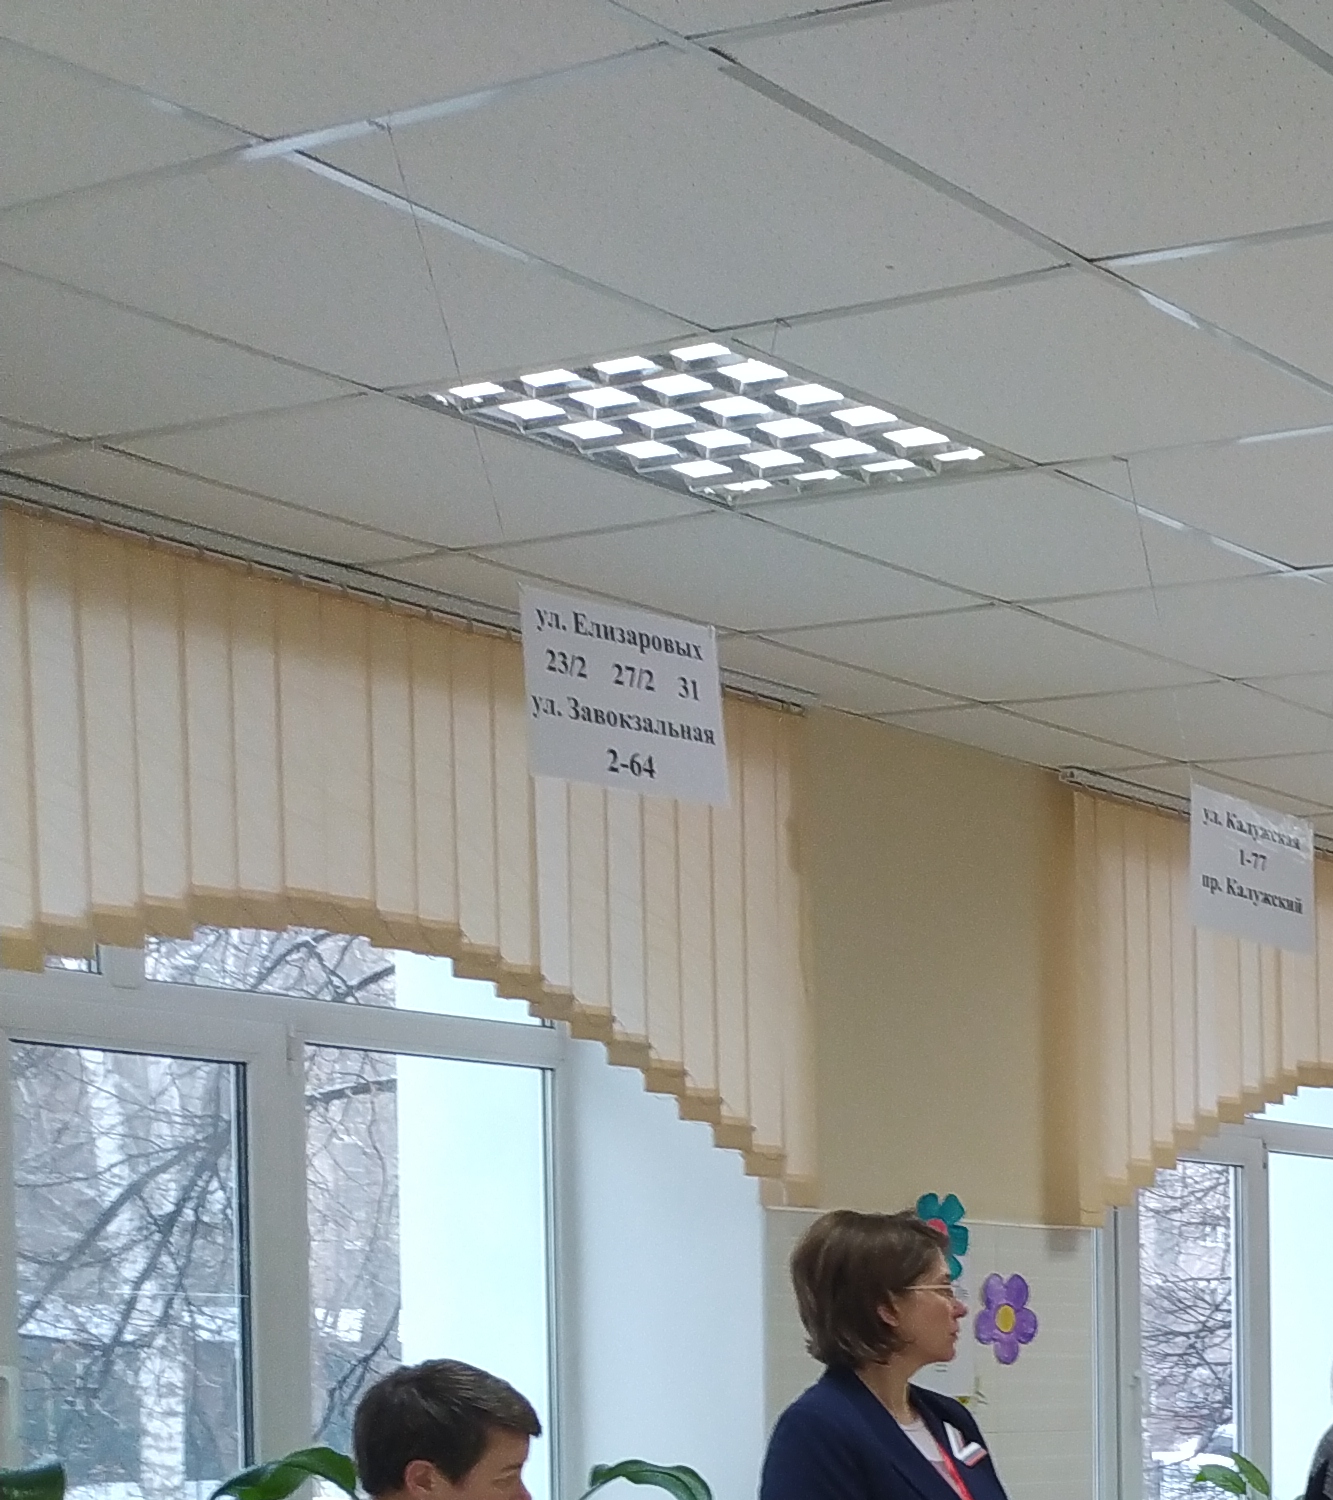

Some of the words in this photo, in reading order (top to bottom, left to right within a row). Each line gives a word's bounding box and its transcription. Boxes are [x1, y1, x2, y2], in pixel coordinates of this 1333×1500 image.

[535, 607, 567, 631] ул.
[572, 611, 703, 661] Елизаровых
[545, 649, 588, 679] 23/2
[612, 663, 656, 692] 27/2
[676, 676, 700, 701] 31
[531, 694, 562, 718] ул.
[567, 696, 716, 746] Завокзальная
[606, 748, 657, 780] 2-64
[1202, 808, 1222, 825] ул.
[1226, 811, 1301, 850] Калужская
[1239, 849, 1267, 872] 1-77
[1202, 874, 1222, 895] пр.
[1226, 877, 1303, 914] Калужский
